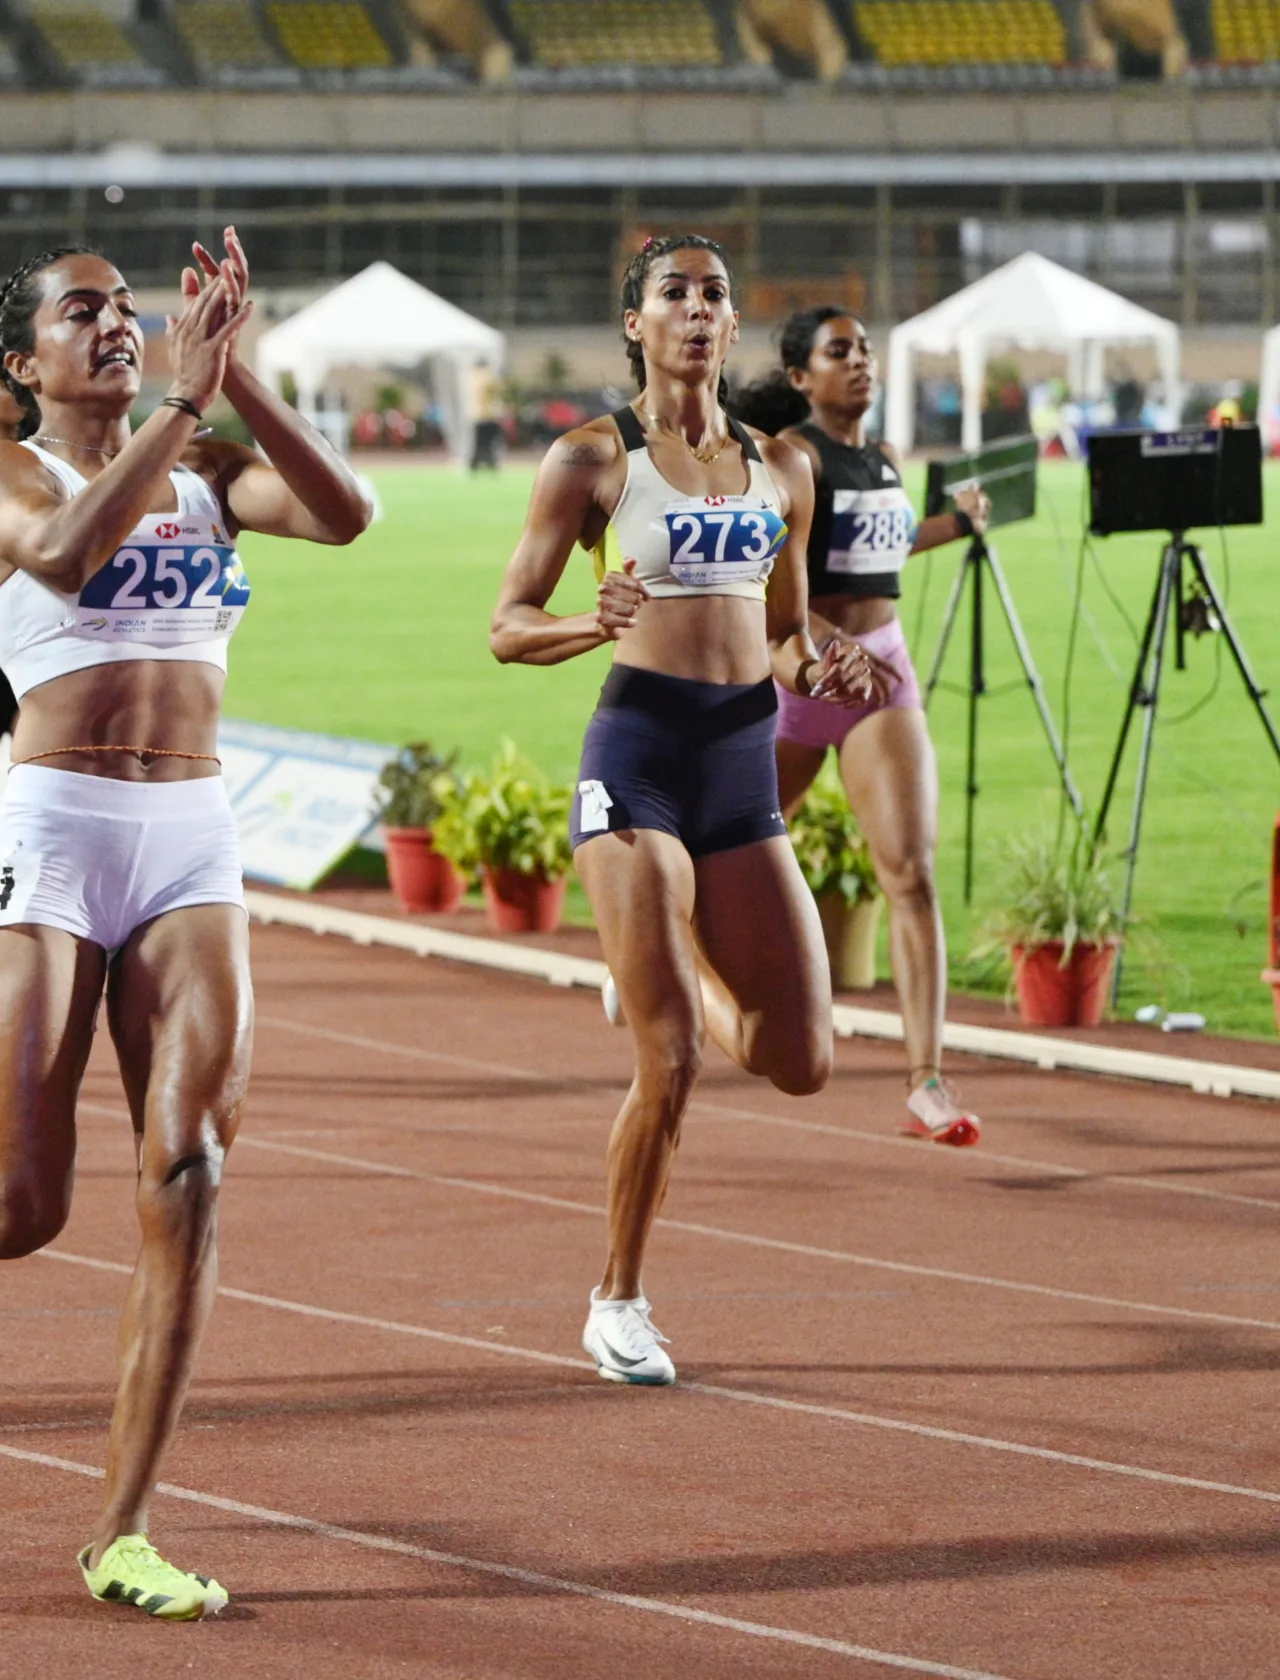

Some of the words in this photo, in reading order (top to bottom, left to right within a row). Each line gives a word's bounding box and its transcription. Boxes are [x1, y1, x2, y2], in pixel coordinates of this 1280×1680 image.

[672, 512, 770, 563] 273
[849, 510, 907, 551] 288
[110, 547, 221, 608] 252
[115, 619, 147, 627] INDIAN
